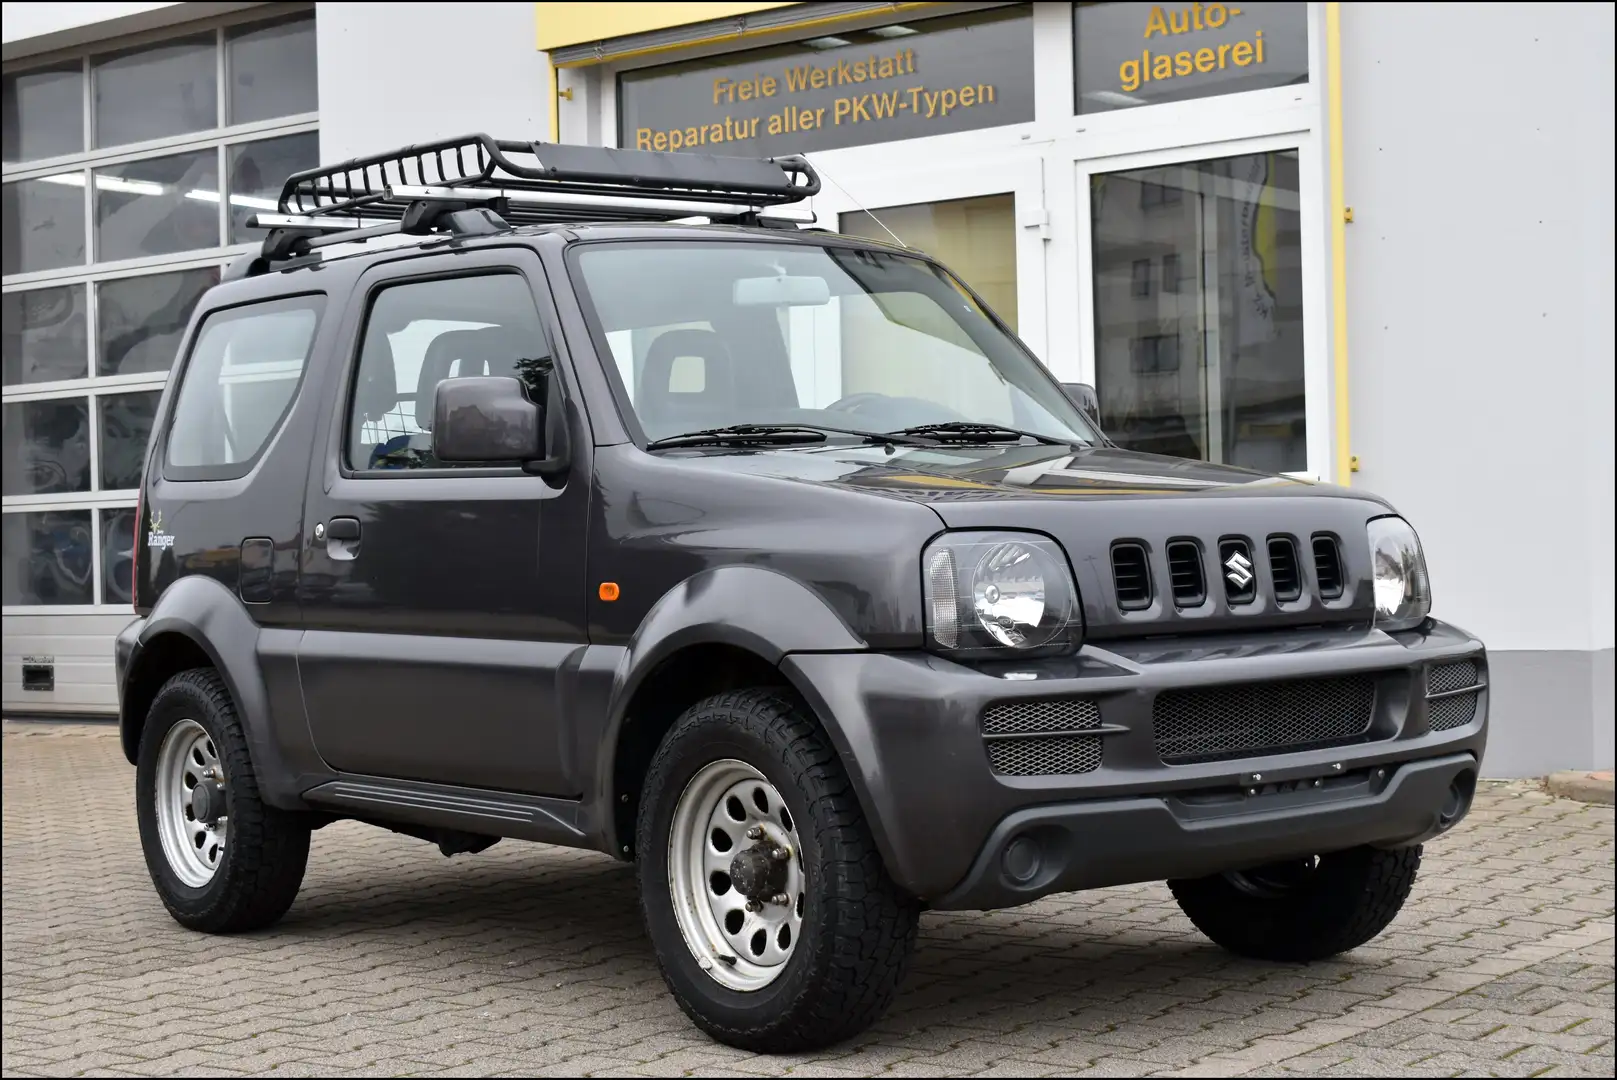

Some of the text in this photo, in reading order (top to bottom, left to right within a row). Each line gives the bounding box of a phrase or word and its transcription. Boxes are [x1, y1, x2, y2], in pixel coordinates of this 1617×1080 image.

[1143, 2, 1241, 38] Auto-
[712, 48, 916, 105] Freie Werkstatt
[1119, 29, 1264, 91] glaserei
[636, 84, 995, 152] Reparatur aller PKW-Typen
[147, 531, 175, 551] Ranger
